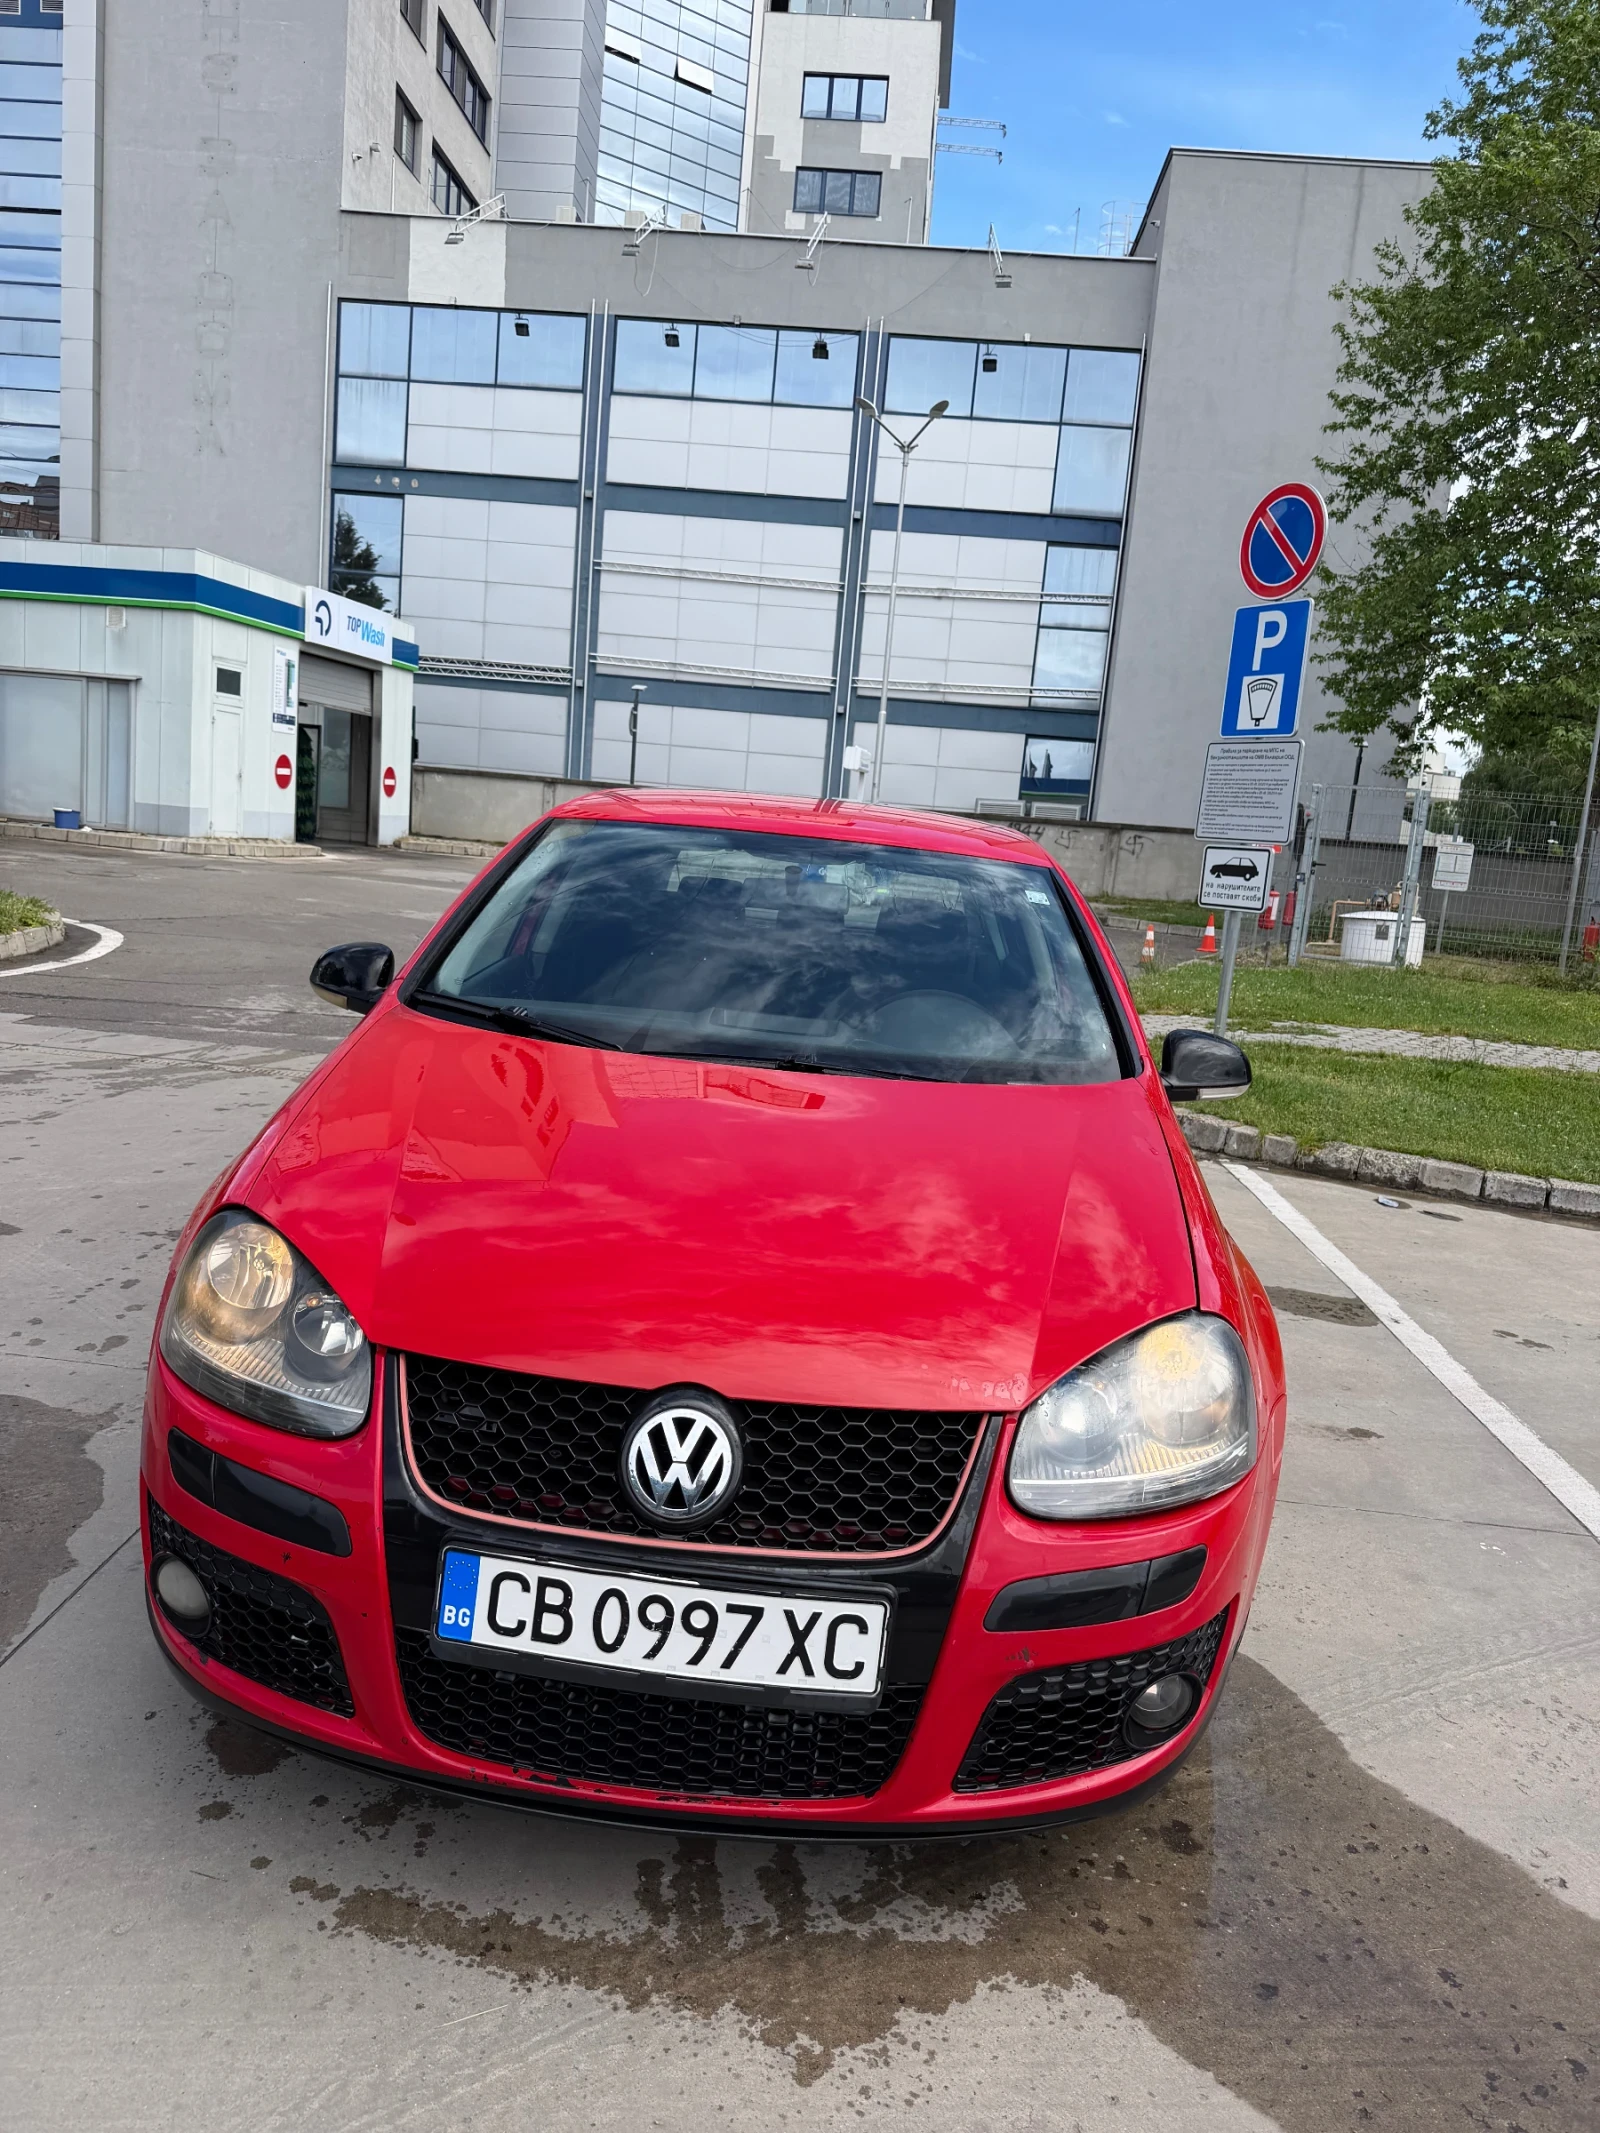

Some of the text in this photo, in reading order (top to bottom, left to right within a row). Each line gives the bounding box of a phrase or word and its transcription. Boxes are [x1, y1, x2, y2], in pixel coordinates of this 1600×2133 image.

[1252, 610, 1287, 671] P
[1212, 892, 1240, 900] поставят
[1242, 894, 1261, 902] скоби
[1217, 883, 1261, 892] нарушителите
[442, 1603, 472, 1628] BG
[592, 1588, 765, 1669] 0997
